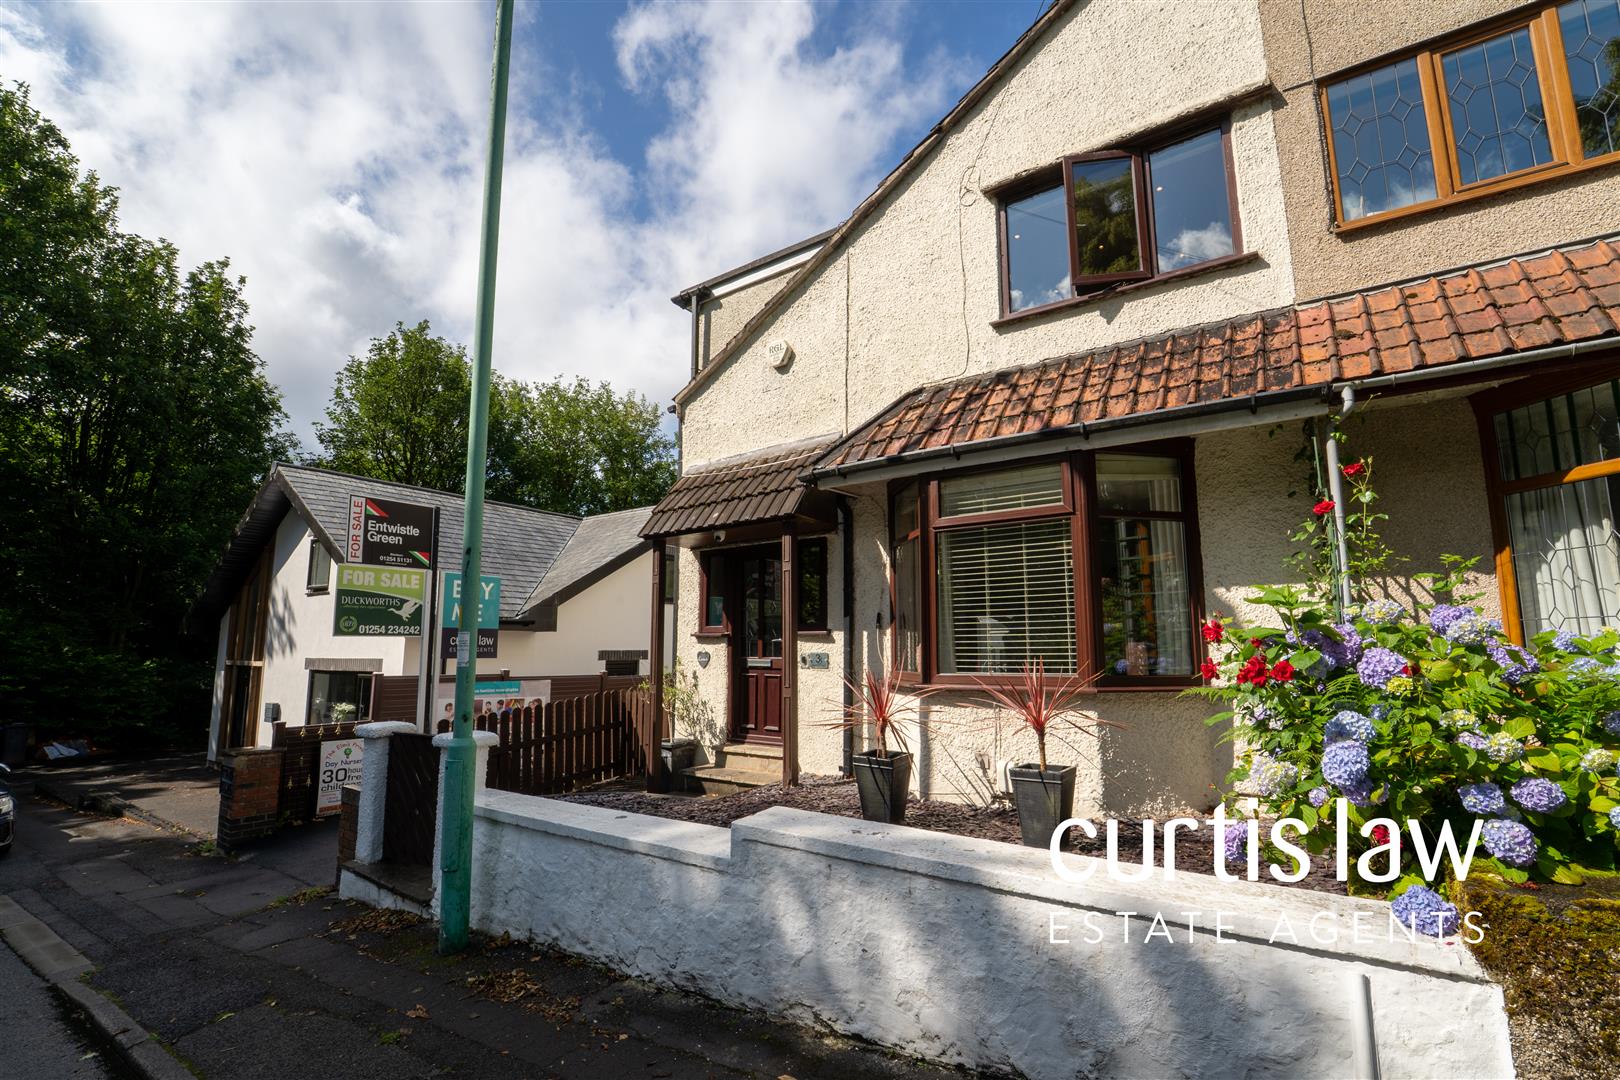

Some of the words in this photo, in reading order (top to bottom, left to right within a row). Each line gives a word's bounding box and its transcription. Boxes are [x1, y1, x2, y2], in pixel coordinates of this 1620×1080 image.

[352, 500, 363, 531] SALE
[367, 520, 420, 536] Entwistle
[367, 531, 403, 545] Green
[351, 534, 361, 559] FOR
[342, 569, 375, 586] FOR
[381, 572, 420, 589] SALE
[452, 579, 495, 600] BY
[341, 595, 401, 607] DUCKWORTHS
[358, 624, 386, 634] 01254
[387, 625, 420, 635] 234242
[478, 635, 495, 646] law
[321, 767, 348, 784] 30
